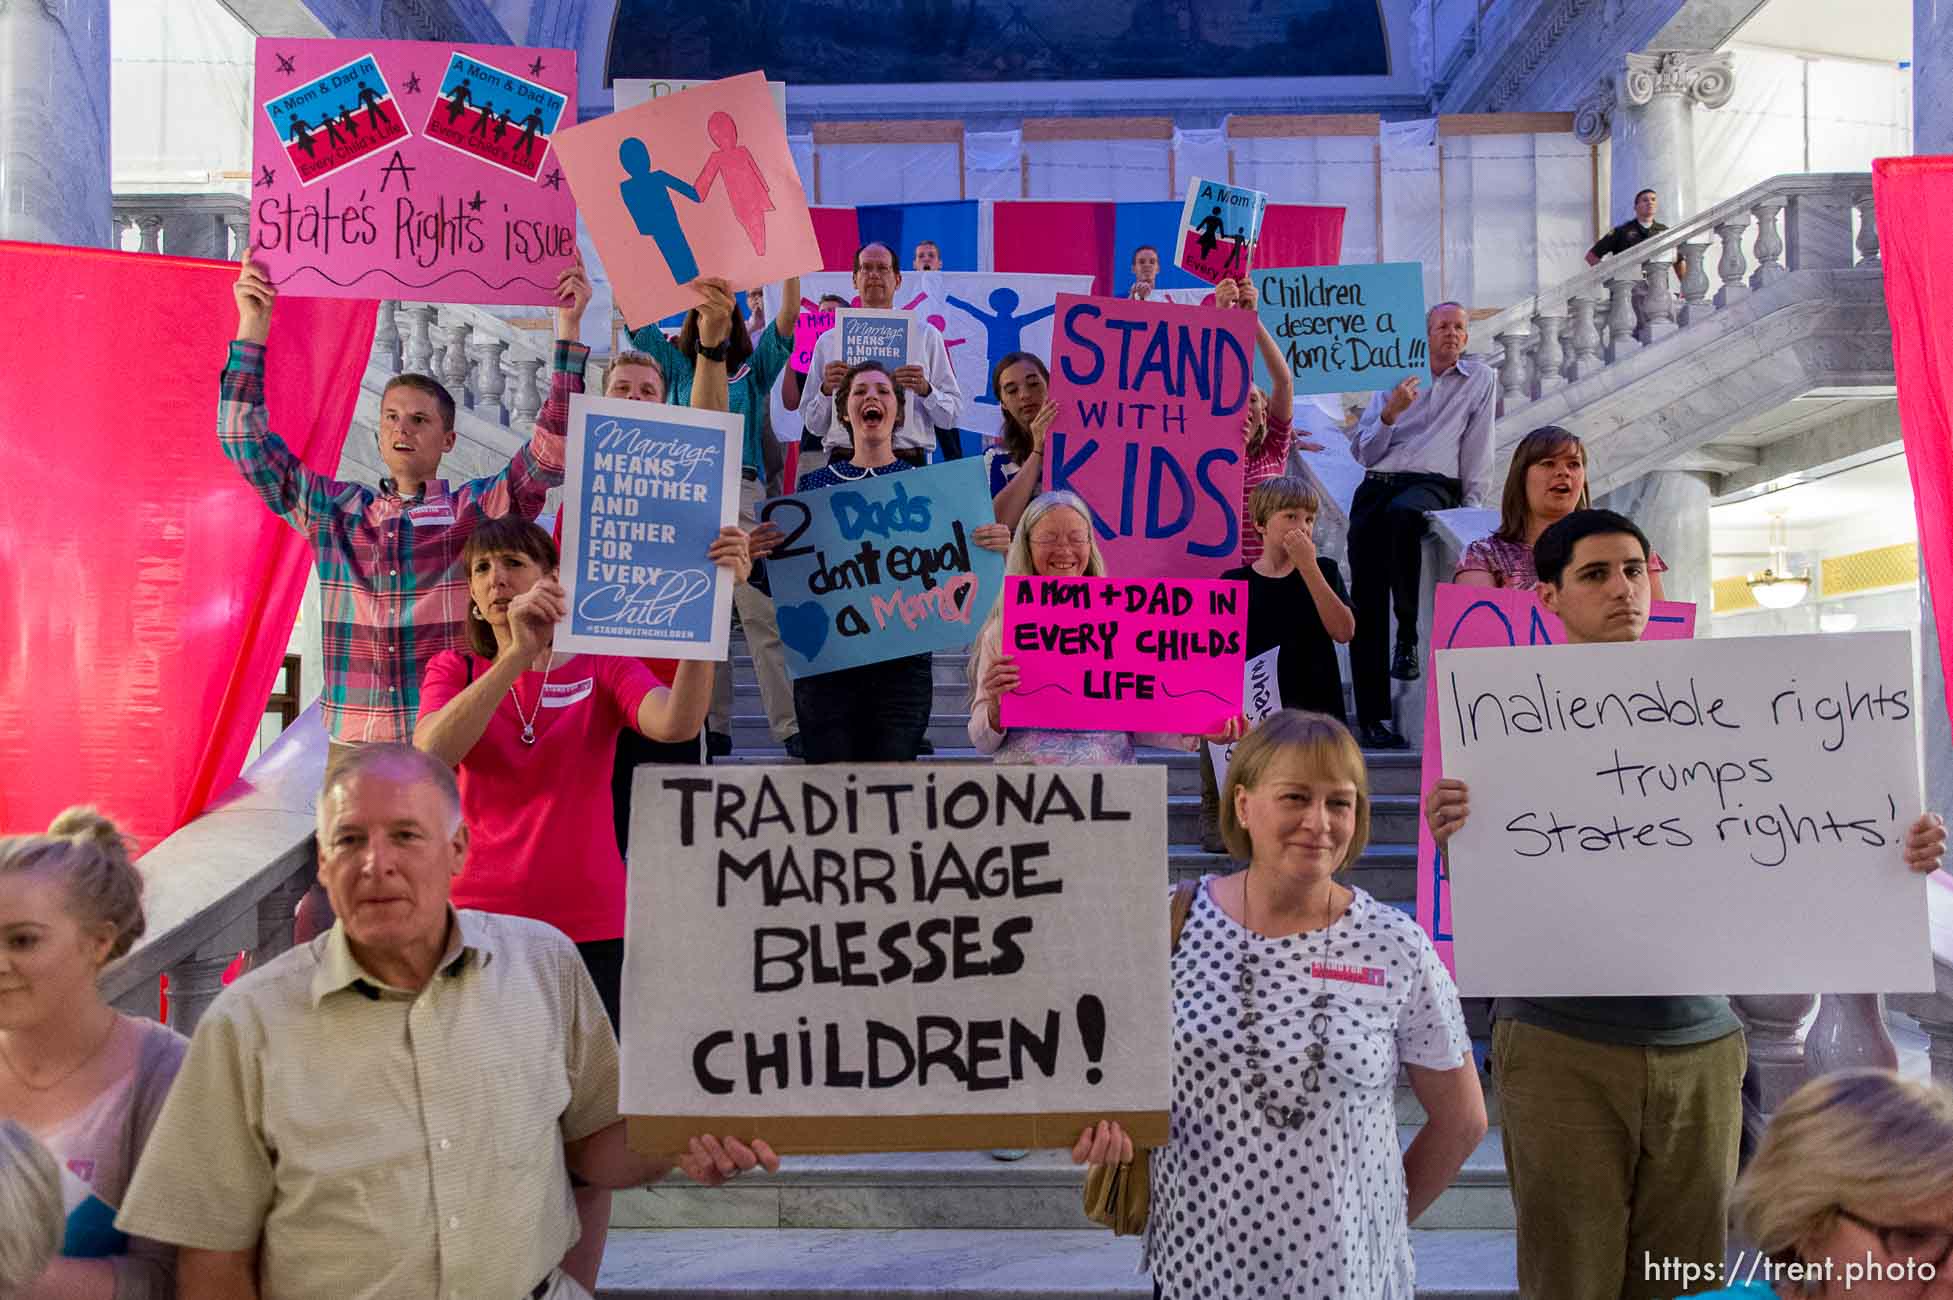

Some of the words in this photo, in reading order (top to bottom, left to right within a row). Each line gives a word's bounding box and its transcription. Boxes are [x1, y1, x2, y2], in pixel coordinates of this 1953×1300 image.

[284, 89, 317, 110] Mom
[320, 83, 330, 94] &
[331, 68, 358, 88] Dad
[360, 62, 374, 75] In
[452, 60, 463, 72] A
[467, 64, 500, 87] Mom
[503, 79, 513, 91] &
[518, 85, 545, 104] Dad
[547, 97, 559, 111] In
[300, 153, 335, 176] Every
[377, 123, 400, 140] Life
[431, 120, 463, 144] Every
[512, 152, 535, 170] Life
[381, 151, 416, 192] A
[1201, 186, 1212, 200] A
[1217, 189, 1249, 208] Mom
[258, 187, 377, 255] State's
[396, 192, 485, 268] Rights
[504, 204, 573, 262] issue
[1187, 256, 1219, 280] Every
[1262, 272, 1367, 309] Children
[847, 335, 885, 346] MEANS
[848, 318, 904, 347] Marriage
[1276, 312, 1369, 338] deserve
[1377, 312, 1398, 334] a
[847, 346, 854, 355] A
[856, 345, 900, 358] MOTHER
[1060, 303, 1251, 417] STAND
[1077, 400, 1188, 434] WITH
[594, 420, 721, 482] Marriage
[594, 452, 676, 477] MEANS
[591, 496, 639, 517] AND
[592, 475, 606, 493] A
[613, 476, 707, 503] MOTHER
[1051, 432, 1239, 558] KIDS
[590, 516, 676, 544] FATHER
[761, 499, 815, 560] 2
[830, 480, 932, 540] Dads
[589, 540, 633, 560] FOR
[886, 519, 971, 590] equal
[587, 560, 662, 586] EVERY
[578, 569, 711, 627] Child
[836, 604, 871, 637] a
[871, 588, 948, 632] Mom
[1016, 579, 1034, 606] A
[1125, 582, 1193, 616] DAD
[1210, 588, 1237, 615] IN
[1014, 621, 1118, 660] EVERY
[1136, 629, 1240, 661] CHILDS
[1083, 670, 1156, 700] LIFE
[1451, 671, 1742, 747] Inalienable
[1771, 679, 1911, 752] rights
[1596, 749, 1773, 811] trumps
[1506, 811, 1694, 857] States
[1715, 793, 1901, 867] rights!
[754, 915, 1033, 993] BLESSES
